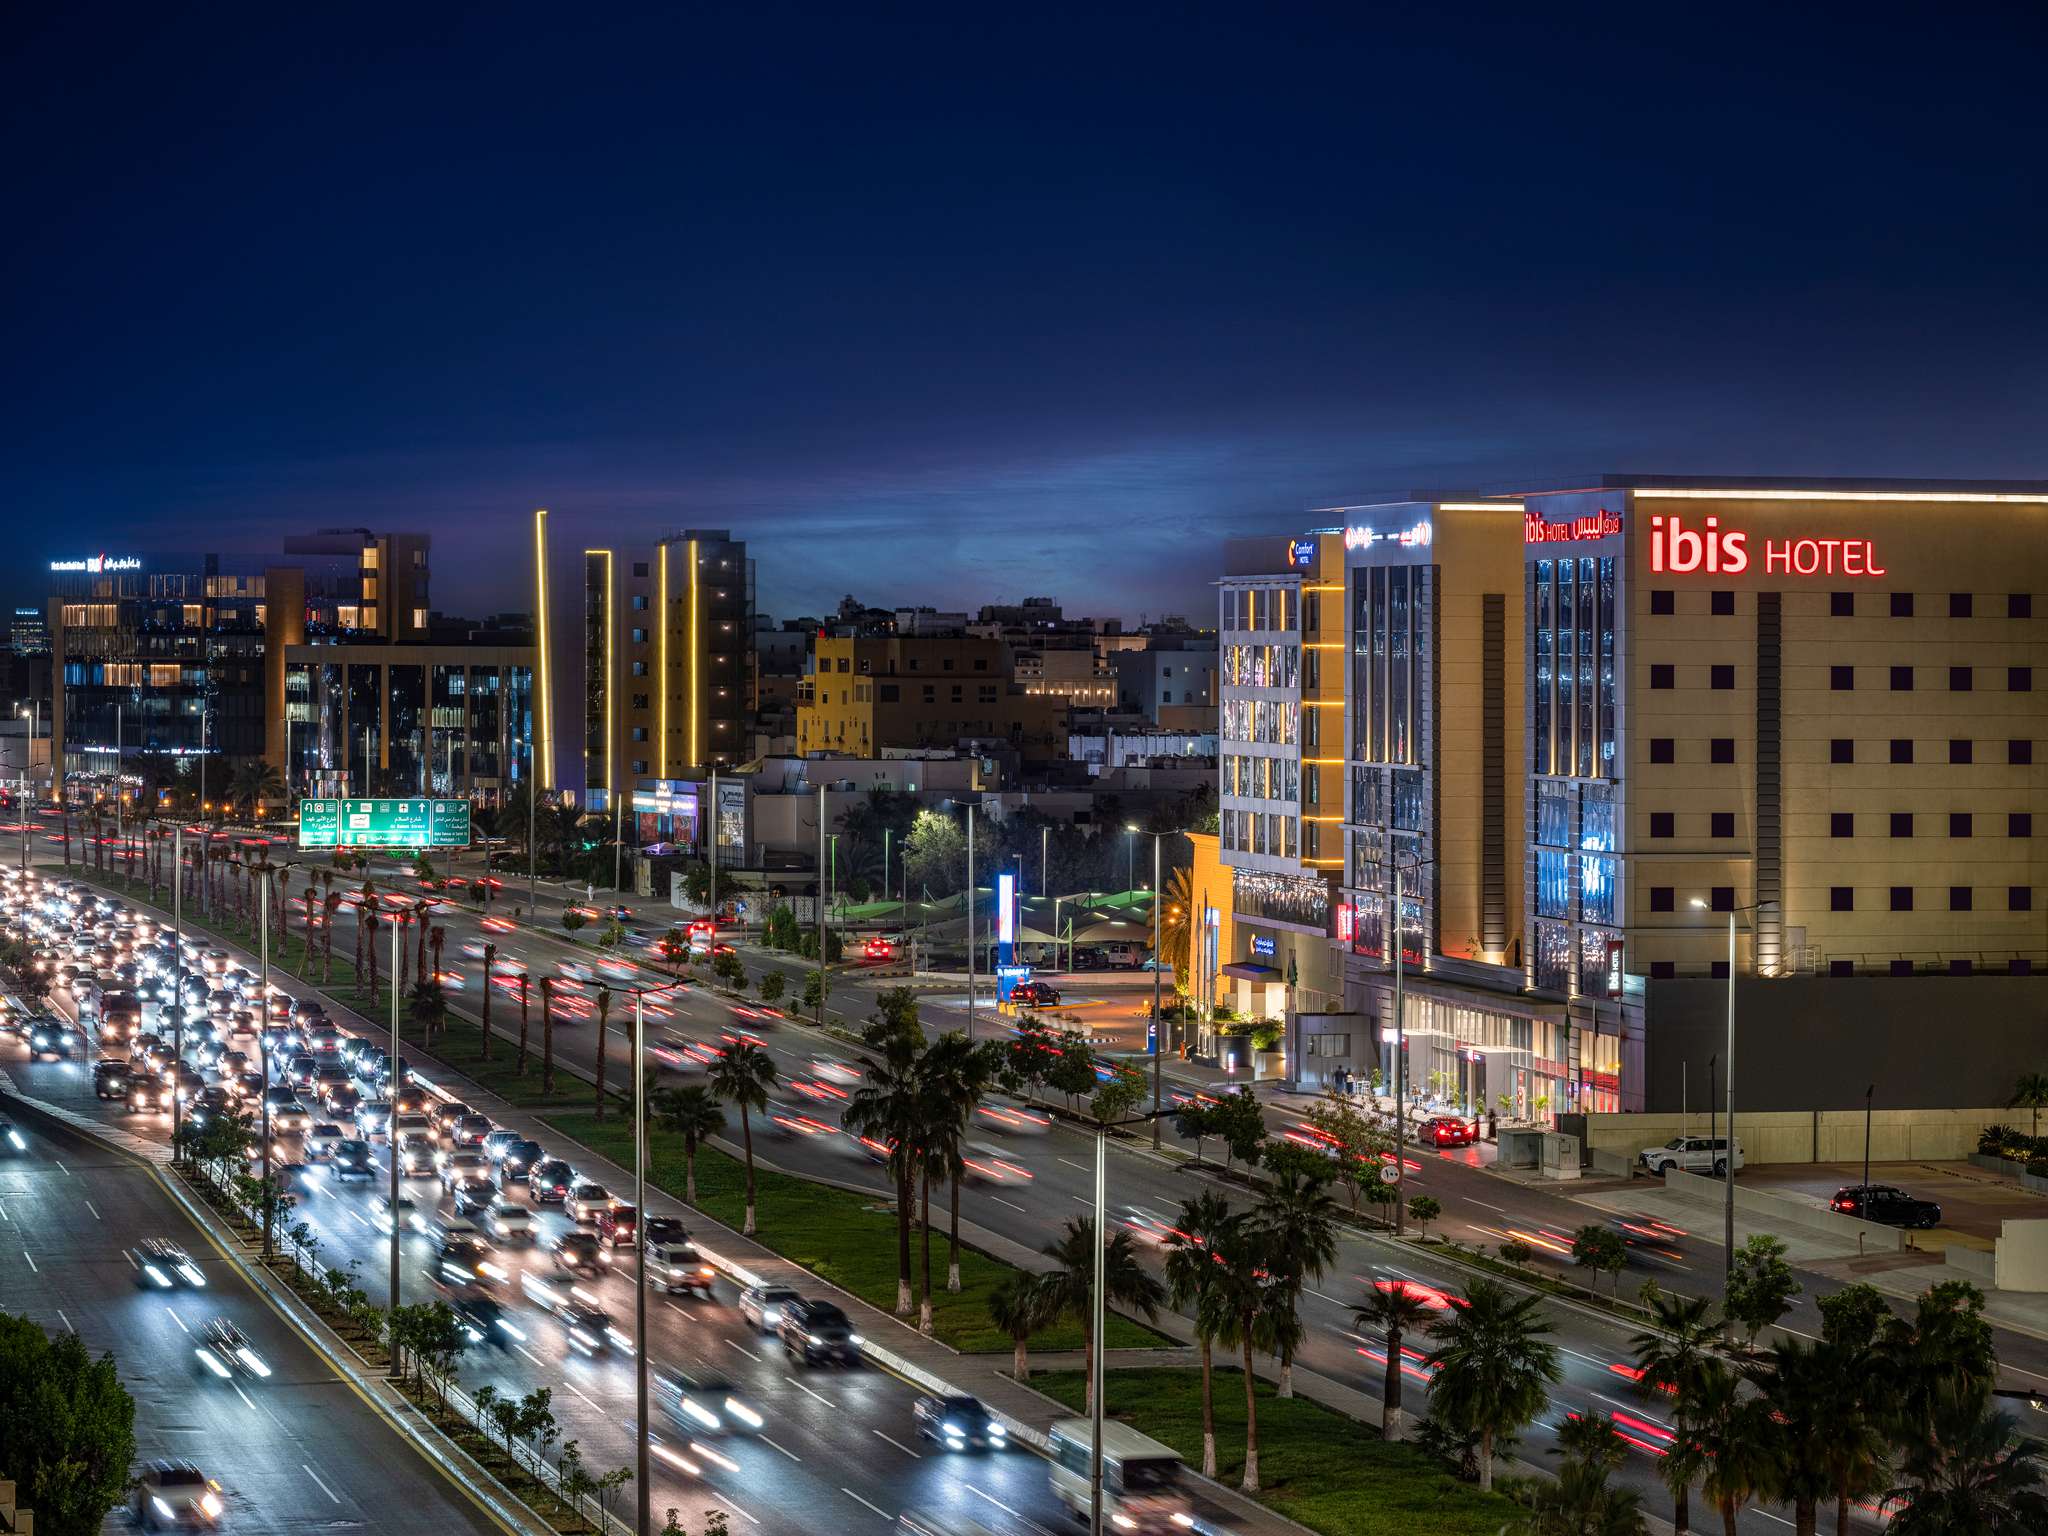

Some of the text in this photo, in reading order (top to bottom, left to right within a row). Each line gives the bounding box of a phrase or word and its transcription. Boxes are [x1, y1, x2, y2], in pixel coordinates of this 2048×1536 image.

[1525, 513, 1571, 543] ibis HOTEL
[1295, 542, 1314, 555] Comfort
[1651, 515, 1887, 576] ibis HOTEL
[1608, 970, 1620, 990] ibis
